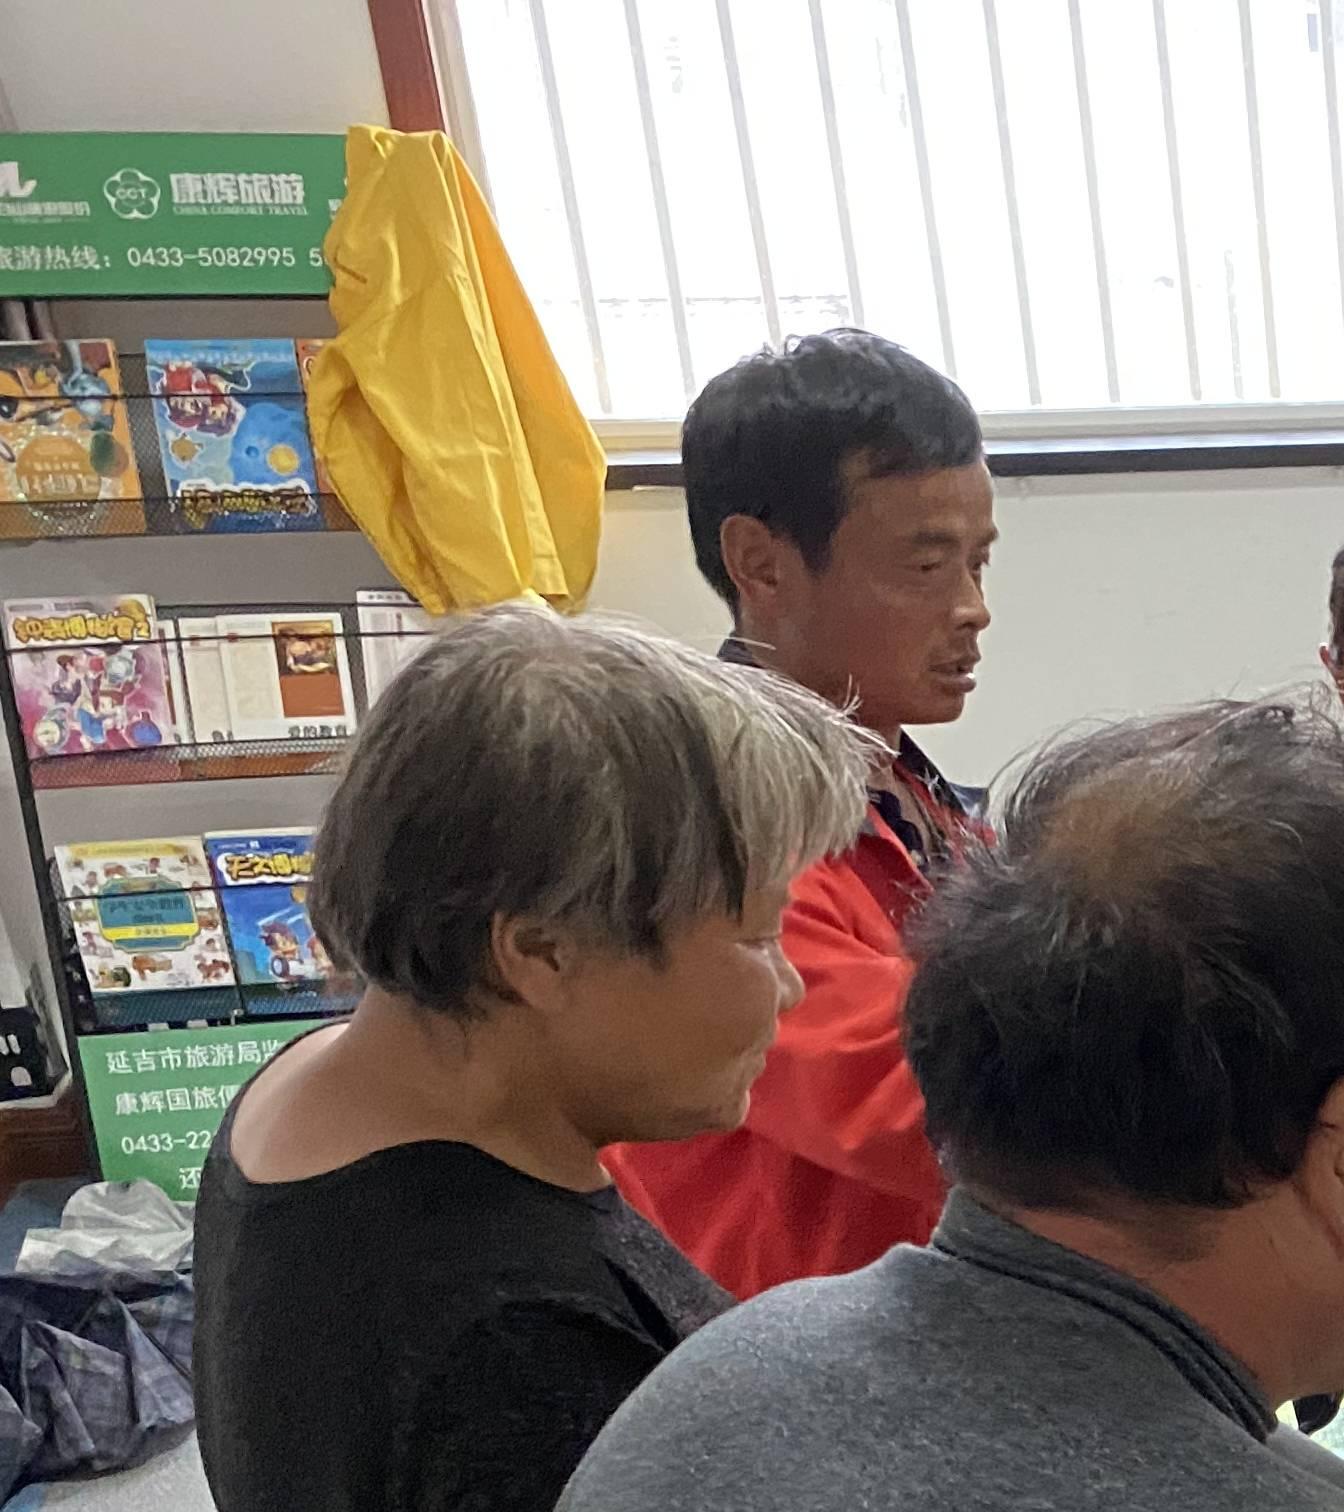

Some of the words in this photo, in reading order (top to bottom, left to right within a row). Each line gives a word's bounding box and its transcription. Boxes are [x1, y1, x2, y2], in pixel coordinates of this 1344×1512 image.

[169, 172, 306, 205] 康辉旅游
[126, 247, 296, 268] 0433-5082995
